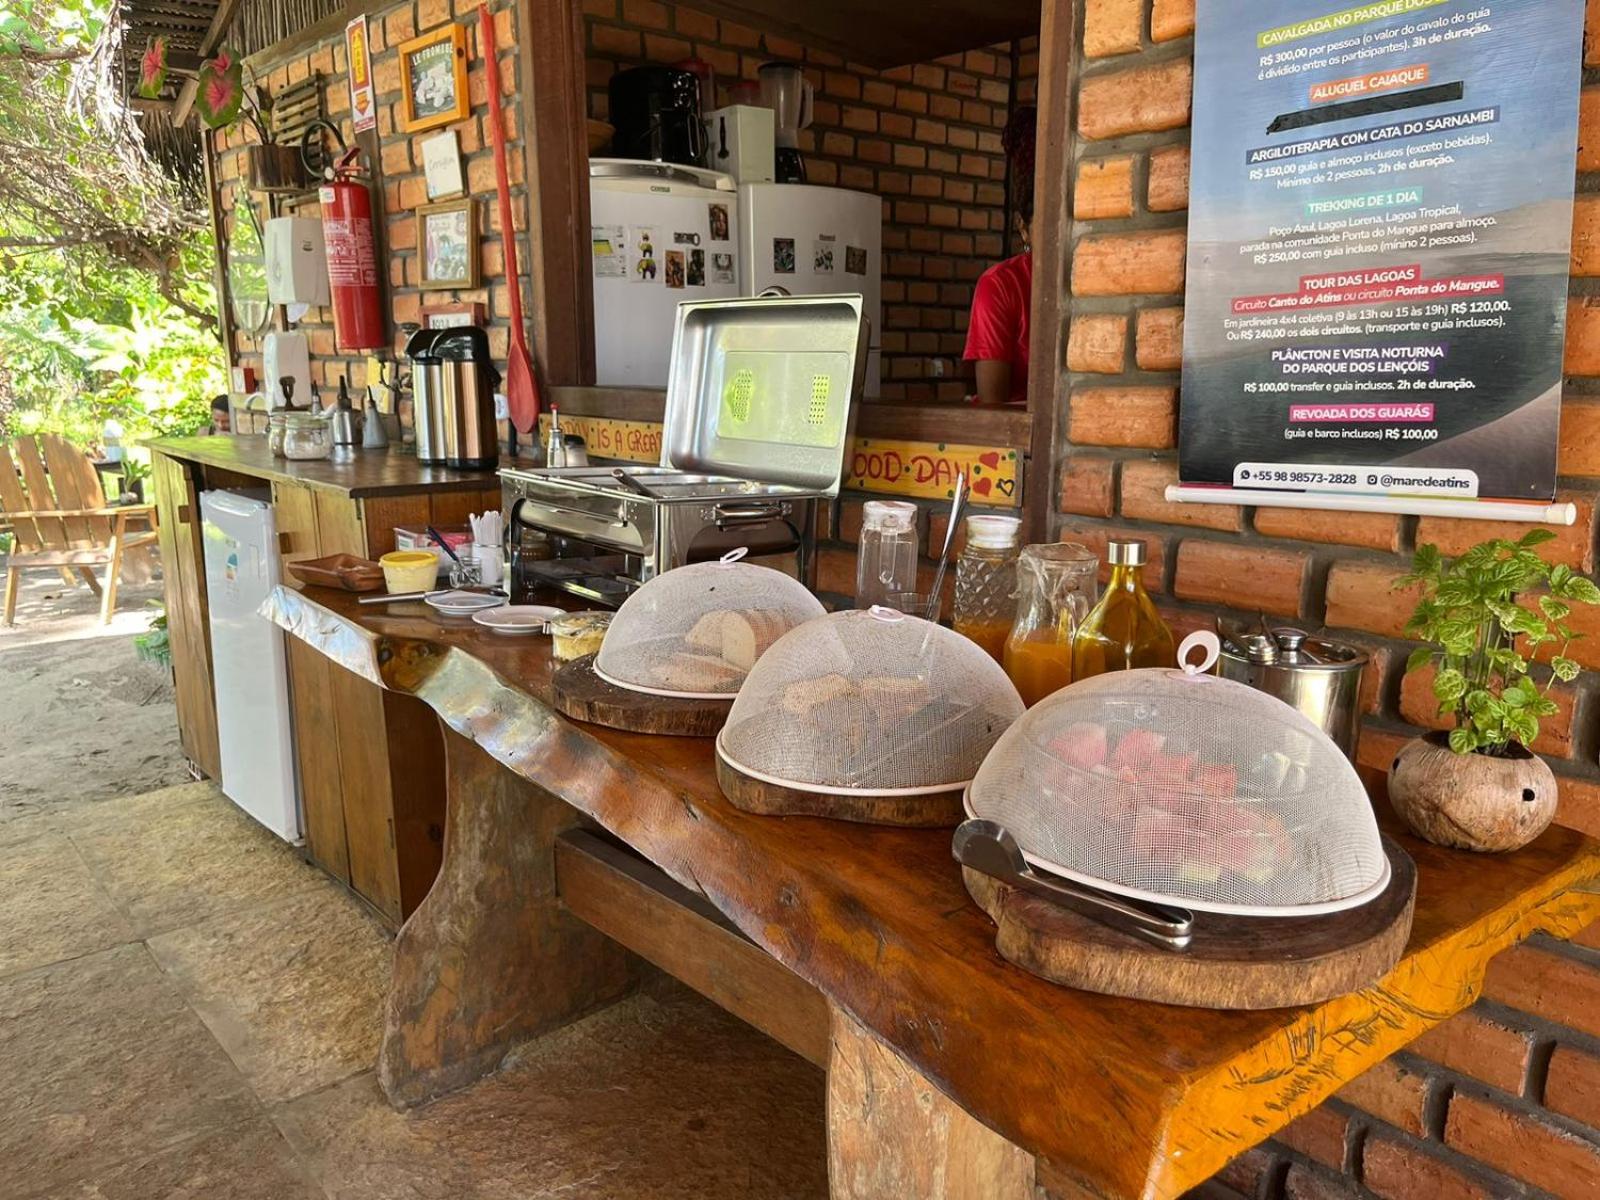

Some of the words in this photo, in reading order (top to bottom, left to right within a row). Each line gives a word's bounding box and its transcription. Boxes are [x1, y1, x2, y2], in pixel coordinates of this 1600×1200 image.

[1263, 22, 1329, 44] CAVALGADA
[1332, 14, 1352, 26] NO
[1354, 0, 1403, 20] PARQUE
[1260, 54, 1273, 66] R$
[1275, 48, 1307, 63] 300,00
[1309, 46, 1326, 58] por
[1327, 38, 1361, 53] pessoa
[1363, 34, 1372, 45] (o
[1374, 29, 1399, 40] valor
[1401, 25, 1414, 35] do
[1416, 17, 1449, 31] cavalo
[1451, 13, 1465, 24] do
[1466, 9, 1490, 22] guia
[1265, 64, 1300, 78] dividido
[1302, 60, 1327, 71] entre
[1328, 57, 1340, 65] os
[1341, 40, 1411, 64] participantes).
[1412, 36, 1427, 47] 3h
[1428, 33, 1442, 43] de
[1443, 24, 1492, 40] duração.
[412, 53, 421, 66] LE
[1313, 80, 1366, 98] ALUGUEL
[1369, 70, 1424, 87] CAIAQUE
[1251, 138, 1339, 161] ARGILOTERAPIA
[1340, 132, 1368, 145] COM
[1370, 127, 1401, 140] CATA
[1404, 122, 1422, 135] DO
[1425, 109, 1494, 131] SARNAMBI
[1249, 169, 1263, 179] R$
[1264, 164, 1296, 177] 150,00
[1298, 161, 1318, 174] guia
[1327, 156, 1362, 167] almoço
[1364, 149, 1404, 161] inclusos
[1445, 133, 1493, 148] bebidas).
[1312, 174, 1325, 183] de
[1326, 171, 1333, 181] 2
[1378, 163, 1391, 173] 2h
[1393, 161, 1407, 171] de
[1409, 156, 1455, 168] duração.
[1308, 198, 1365, 212] TREKKING
[1367, 195, 1383, 206] DE
[1386, 195, 1393, 204] 1
[1396, 192, 1418, 203] DIA
[1269, 227, 1294, 236] Poço
[1318, 220, 1347, 231] Lagoa
[1386, 212, 1417, 223] Lagoa
[1419, 204, 1461, 218] Tropical,
[1240, 242, 1270, 254] parada
[1284, 233, 1341, 248] comunidade
[1342, 231, 1370, 241] Ponta
[1372, 227, 1385, 237] do
[1387, 225, 1428, 235] Mangue
[1429, 221, 1454, 232] para
[1456, 217, 1497, 228] almoço.
[1254, 254, 1267, 264] R$
[1268, 250, 1300, 262] 250,00
[1302, 251, 1322, 259] com
[1324, 248, 1344, 259] guia
[1346, 244, 1378, 254] incluso
[1419, 236, 1427, 246] 2
[1429, 232, 1477, 247] pessoas).
[1304, 278, 1335, 289] TOUR
[1338, 275, 1362, 286] DAS
[1364, 269, 1414, 283] LAGOAS
[1234, 300, 1266, 310] Circuito
[1268, 298, 1298, 307] Canto
[1300, 295, 1313, 304] do
[1316, 292, 1342, 303] Atins
[1343, 293, 1357, 301] ou
[1358, 288, 1393, 299] circuito
[1395, 285, 1429, 295] Ponta
[1431, 283, 1447, 293] do
[1449, 280, 1500, 291] Mangue.
[1224, 319, 1238, 328] Em
[1238, 317, 1278, 329] jardineira
[1279, 315, 1297, 324] 4x4
[1298, 314, 1333, 323] coletiva
[1335, 312, 1344, 322] (9
[1346, 311, 1358, 320] às
[1360, 309, 1378, 319] 13h
[1395, 307, 1408, 317] 15
[1411, 306, 1423, 316] às
[1425, 305, 1449, 316] 19h)
[1451, 302, 1467, 314] R$
[1469, 301, 1512, 312] 120,00.
[1227, 331, 1240, 340] Ou
[1240, 329, 1253, 340] R$
[1254, 329, 1286, 338] 240,00
[1300, 326, 1319, 336] dois
[1321, 324, 1363, 335] circuitos.
[1365, 322, 1420, 334] (transporte
[1431, 321, 1454, 331] guia
[1456, 316, 1506, 328] inclusos).
[1272, 348, 1332, 360] PLÂNCTON
[1333, 349, 1340, 359] E
[1342, 349, 1379, 358] VISITA
[1381, 347, 1444, 358] NOTURNA
[1283, 364, 1301, 373] DO
[1302, 363, 1347, 375] PARQUE
[1349, 362, 1376, 372] DOS
[1377, 359, 1430, 374] LENÇÓIS
[1244, 383, 1257, 392] R$
[1259, 383, 1289, 392] 100,00
[1290, 382, 1325, 391] transfer
[1333, 381, 1353, 392] guia
[1354, 381, 1395, 390] inclusos.
[1397, 380, 1410, 389] 2h
[1413, 380, 1426, 389] de
[1428, 378, 1476, 391] duração.
[1293, 409, 1348, 419] REVOADA
[1350, 409, 1375, 418] DOS
[1378, 405, 1430, 417] GUARÁS
[596, 422, 611, 449] IS
[615, 430, 623, 452] A
[1284, 428, 1306, 439] (guia
[1315, 429, 1340, 438] barco
[1342, 429, 1383, 439] inclusos)
[1385, 428, 1400, 439] R$
[1402, 429, 1438, 440] 100,00
[853, 451, 902, 483] OOD
[1253, 471, 1272, 481] +55
[1274, 472, 1288, 481] 98
[1290, 472, 1357, 484] 98573-2828
[1380, 475, 1470, 488] @maredeatins
